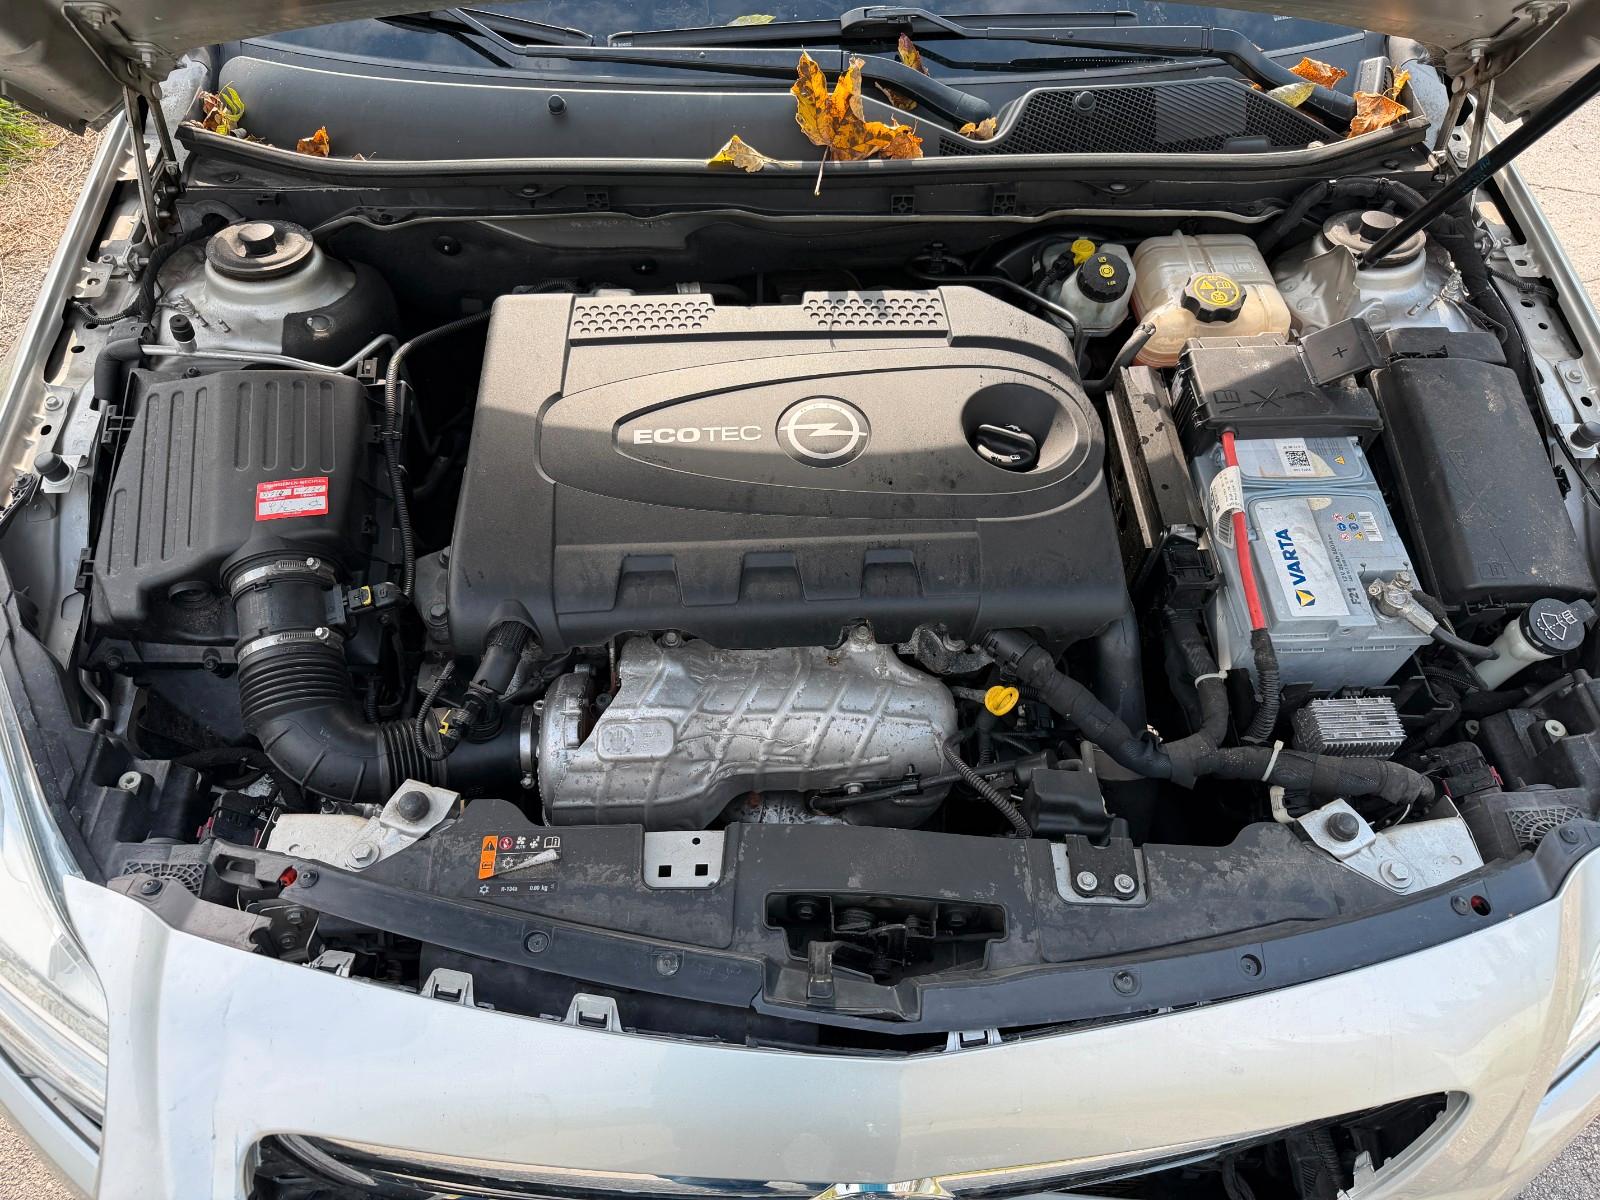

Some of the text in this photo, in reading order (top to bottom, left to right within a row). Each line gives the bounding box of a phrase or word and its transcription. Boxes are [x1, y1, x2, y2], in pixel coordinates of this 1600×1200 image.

[633, 425, 762, 445] ECOTEC
[1275, 528, 1307, 586] VARTA
[1347, 587, 1361, 605] F21
